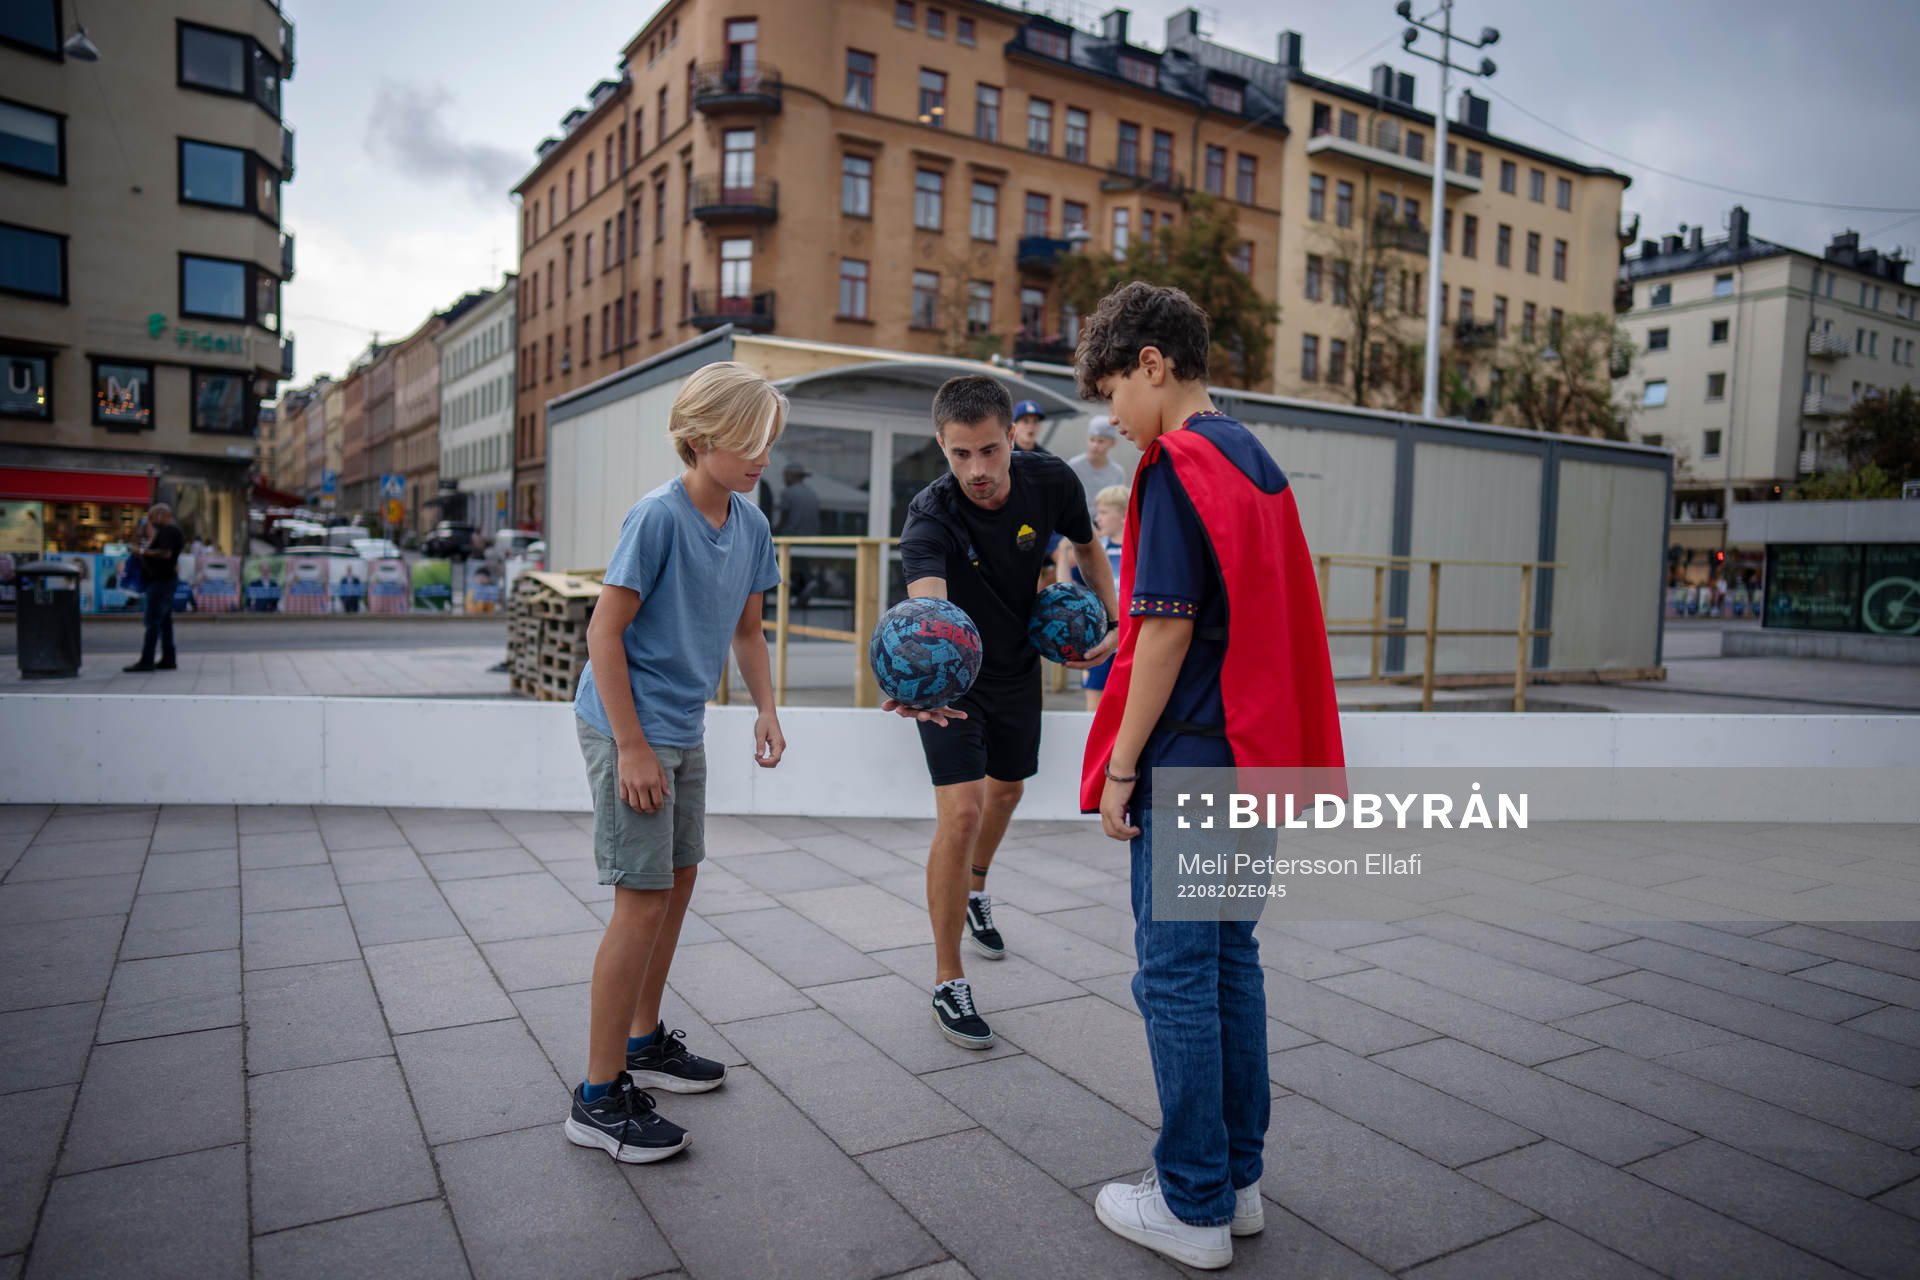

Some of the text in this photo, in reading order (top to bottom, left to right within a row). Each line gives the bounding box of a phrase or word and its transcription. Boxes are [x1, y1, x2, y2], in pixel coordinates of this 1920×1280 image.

[8, 366, 140, 403] U M
[916, 620, 979, 652] STREET
